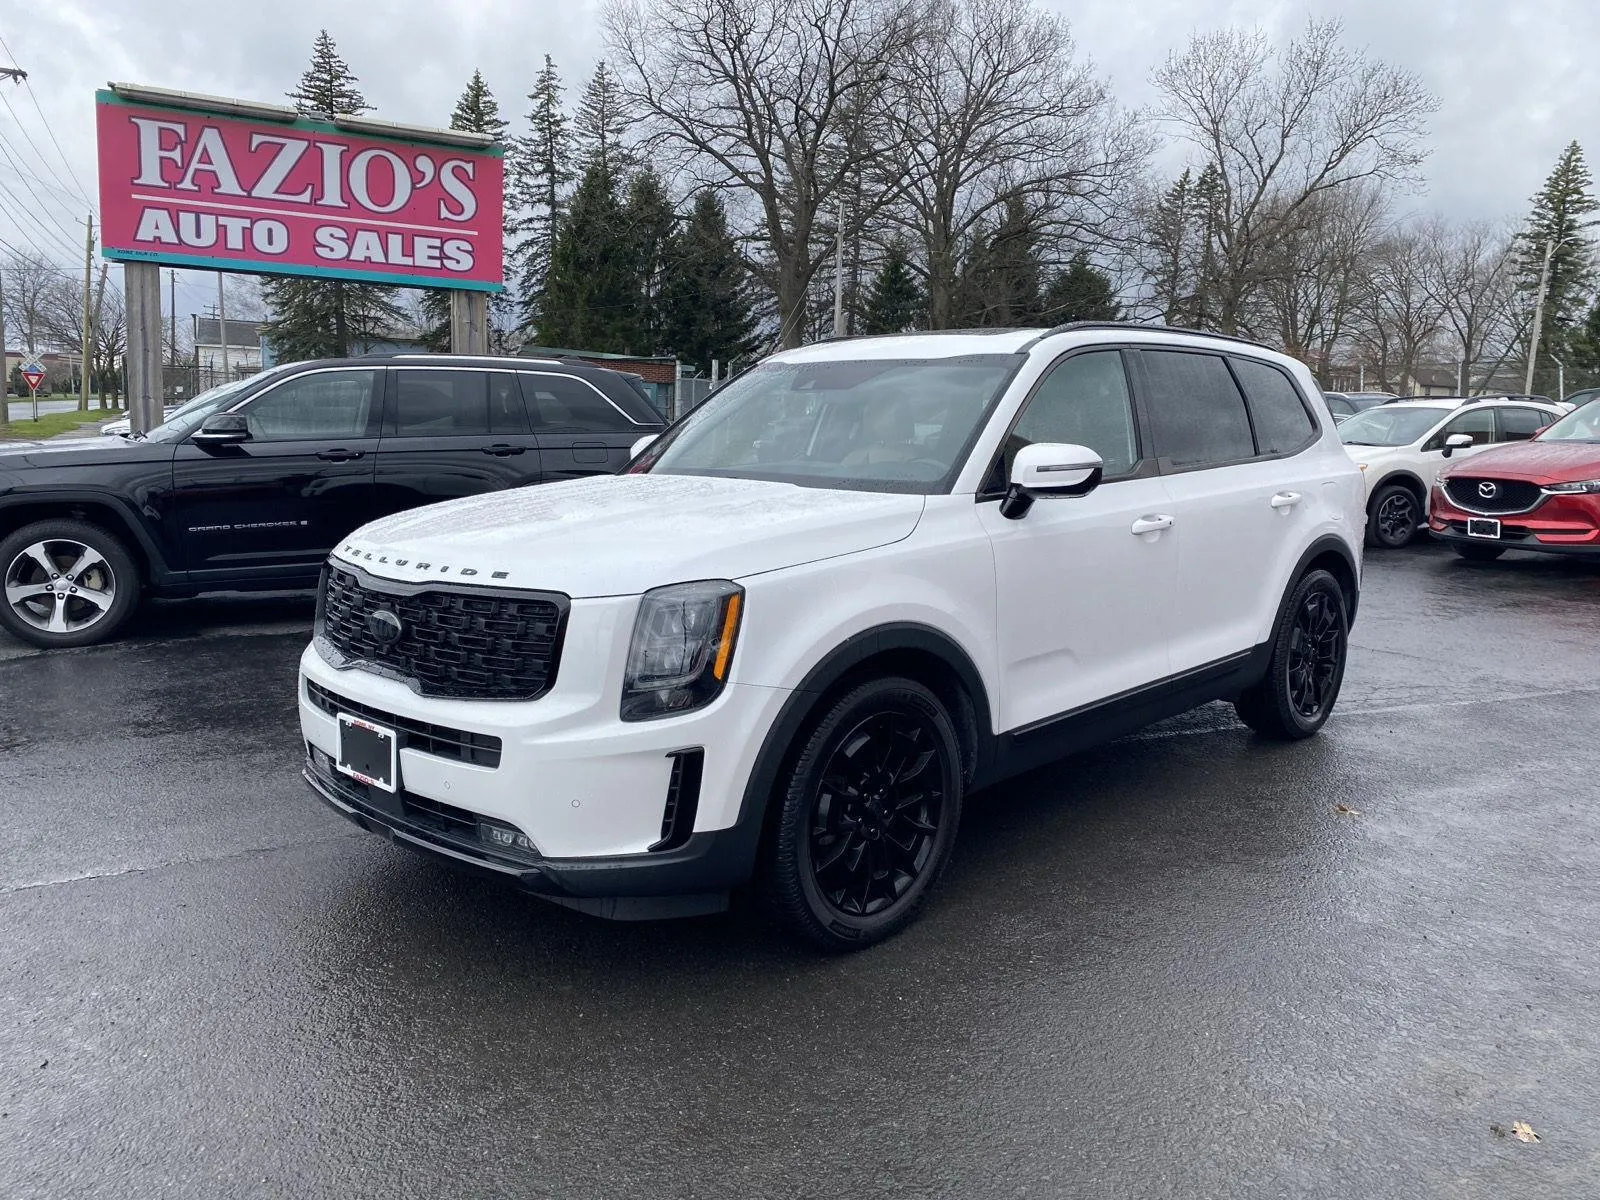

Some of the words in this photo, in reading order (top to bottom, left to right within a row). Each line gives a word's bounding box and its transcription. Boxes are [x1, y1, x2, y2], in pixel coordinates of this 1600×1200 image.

[130, 116, 478, 222] FAZIO'S
[134, 207, 289, 255] AUTO
[314, 225, 475, 272] SALES
[188, 524, 231, 532] GRAND
[234, 520, 297, 529] CHEROKEE
[344, 545, 510, 580] TELLURIDE
